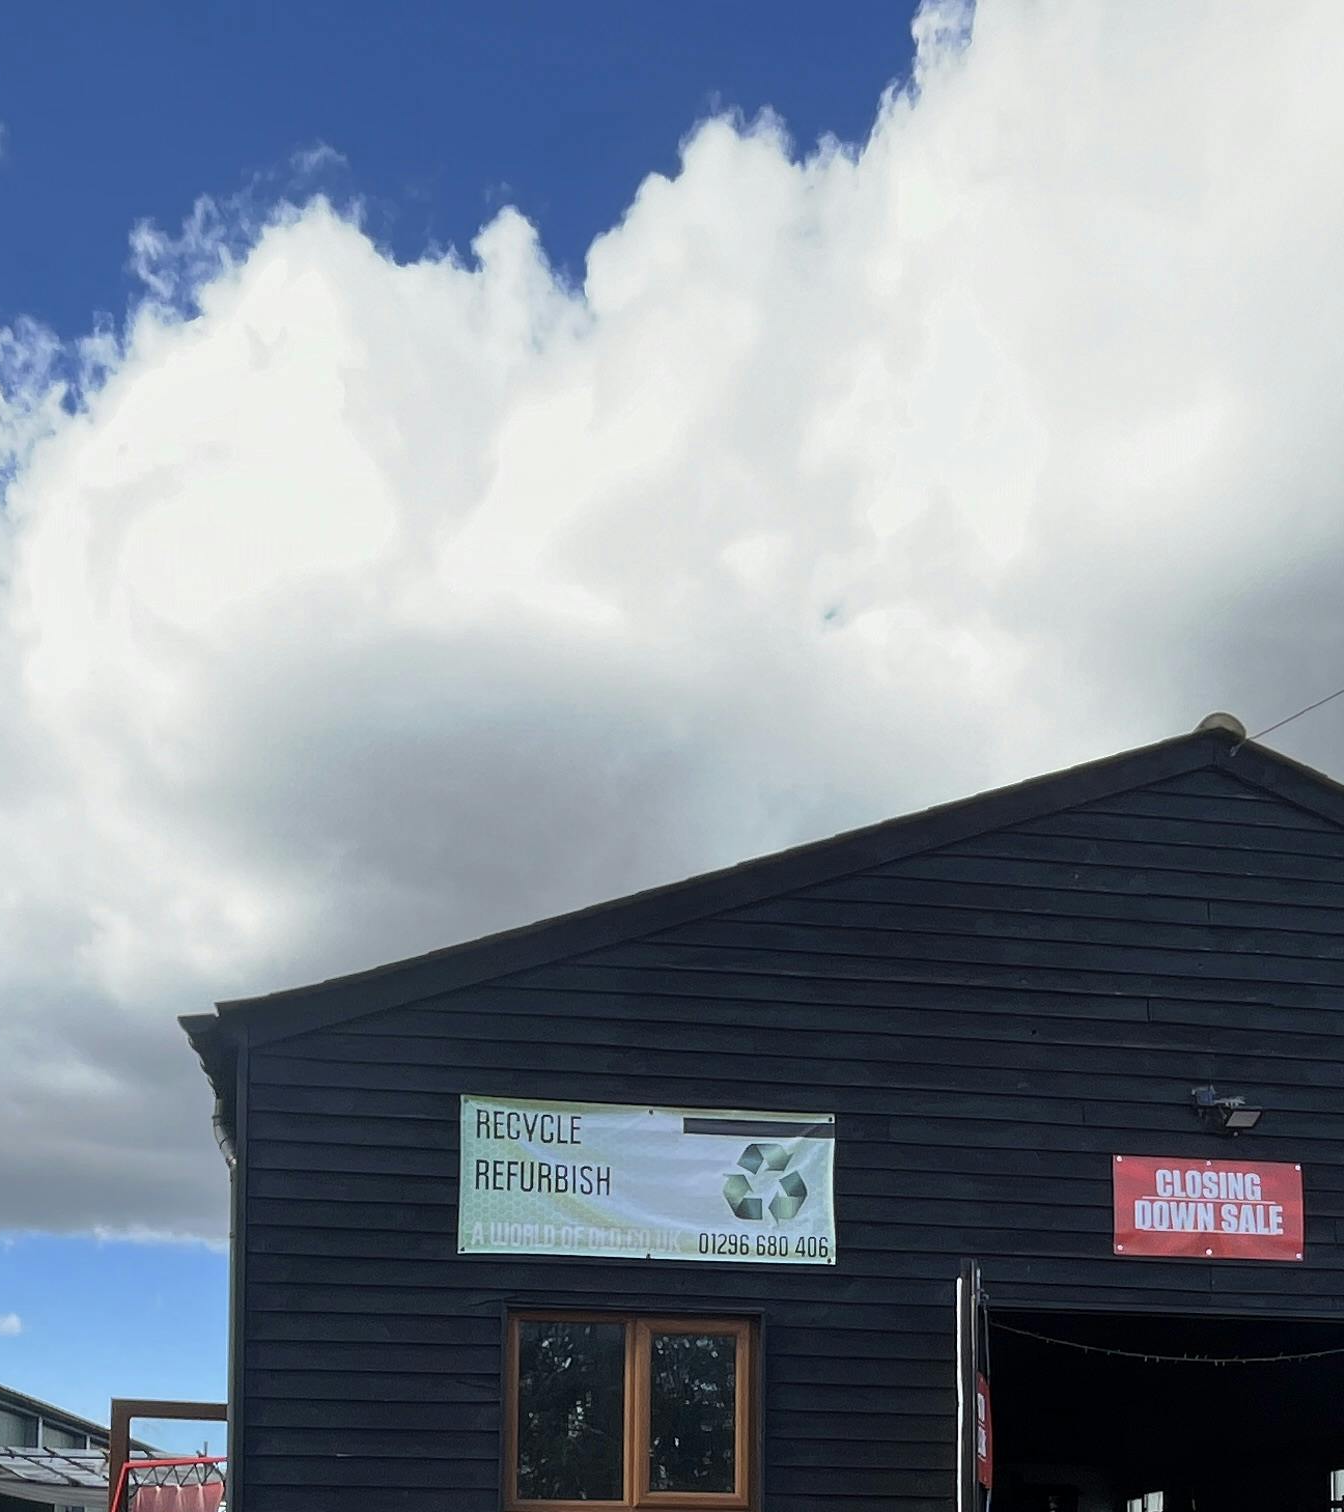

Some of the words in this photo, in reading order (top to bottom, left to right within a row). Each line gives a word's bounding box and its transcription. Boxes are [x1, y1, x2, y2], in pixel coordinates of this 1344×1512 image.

[476, 1109, 581, 1144] RECYCLE
[475, 1159, 611, 1196] REFURBISH
[1156, 1169, 1261, 1200] CLOSING
[1135, 1200, 1216, 1232] DOWN
[1221, 1204, 1284, 1236] SALE
[471, 1221, 484, 1246] A
[490, 1222, 555, 1247] WORLD
[561, 1225, 584, 1249] OF
[698, 1233, 749, 1255] 01296
[756, 1235, 788, 1256] 680
[794, 1236, 828, 1258] 406
